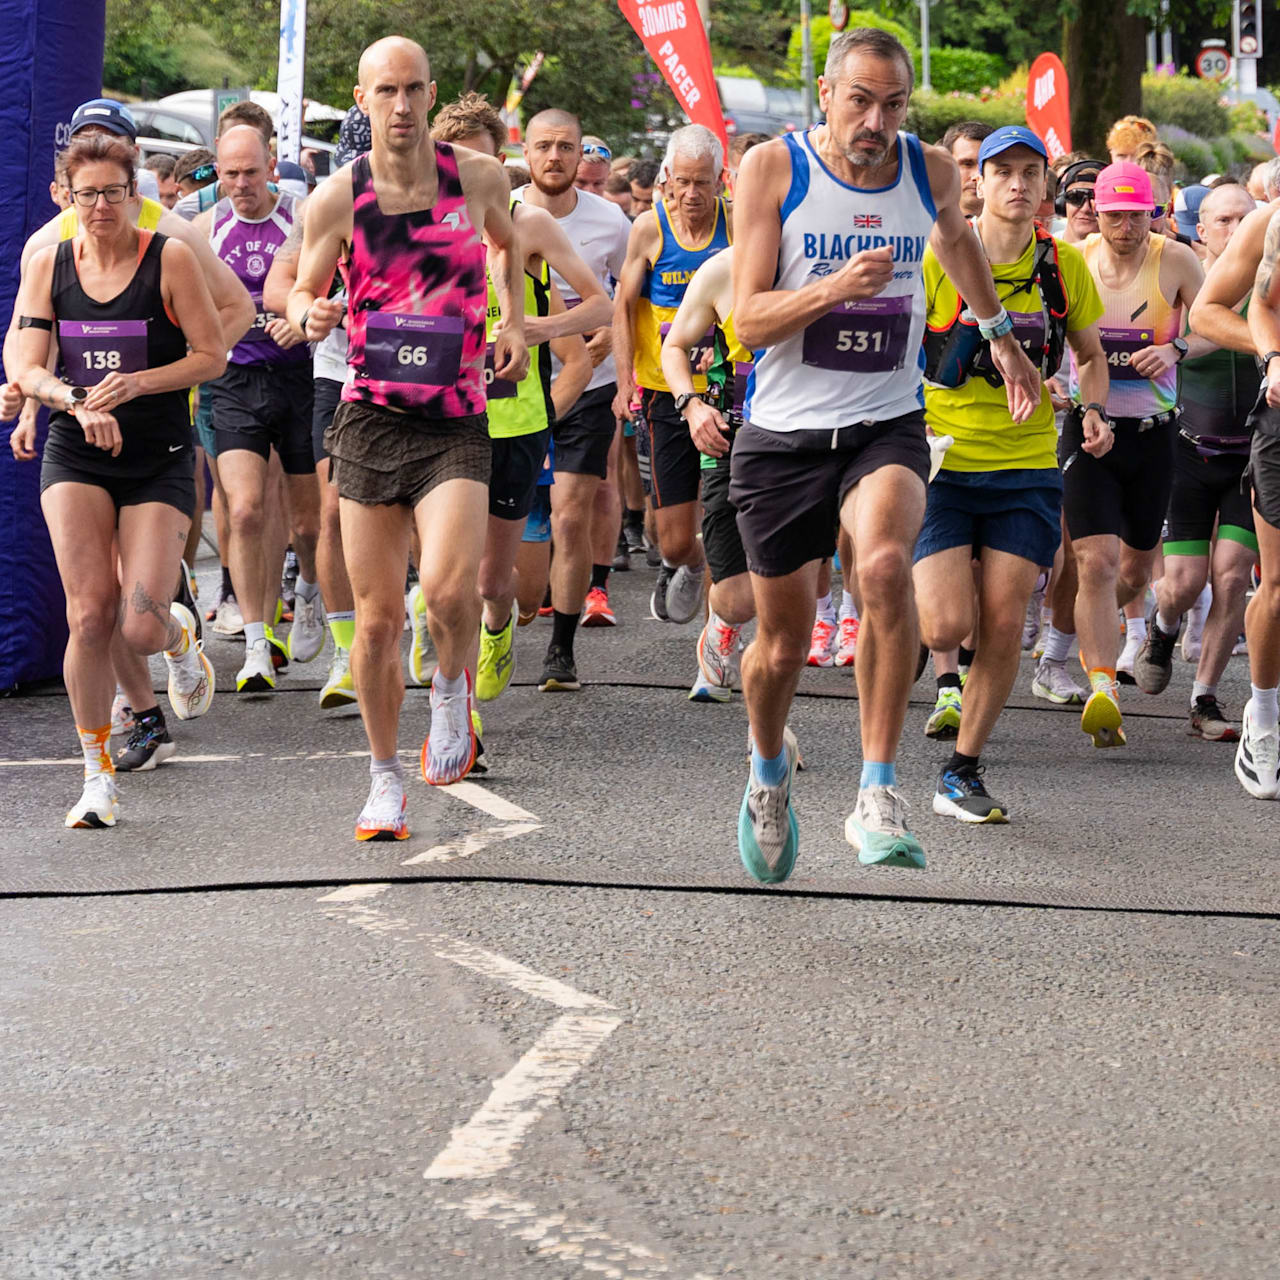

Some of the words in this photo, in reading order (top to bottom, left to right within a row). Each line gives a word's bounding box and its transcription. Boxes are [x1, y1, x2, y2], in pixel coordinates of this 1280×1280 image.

[638, 0, 687, 38] 30MINS
[658, 40, 701, 109] PACER
[1202, 58, 1226, 72] 30
[246, 241, 261, 251] OF
[836, 330, 882, 352] 531
[82, 350, 121, 370] 138
[397, 345, 428, 366] 66
[1106, 351, 1130, 367] 49
